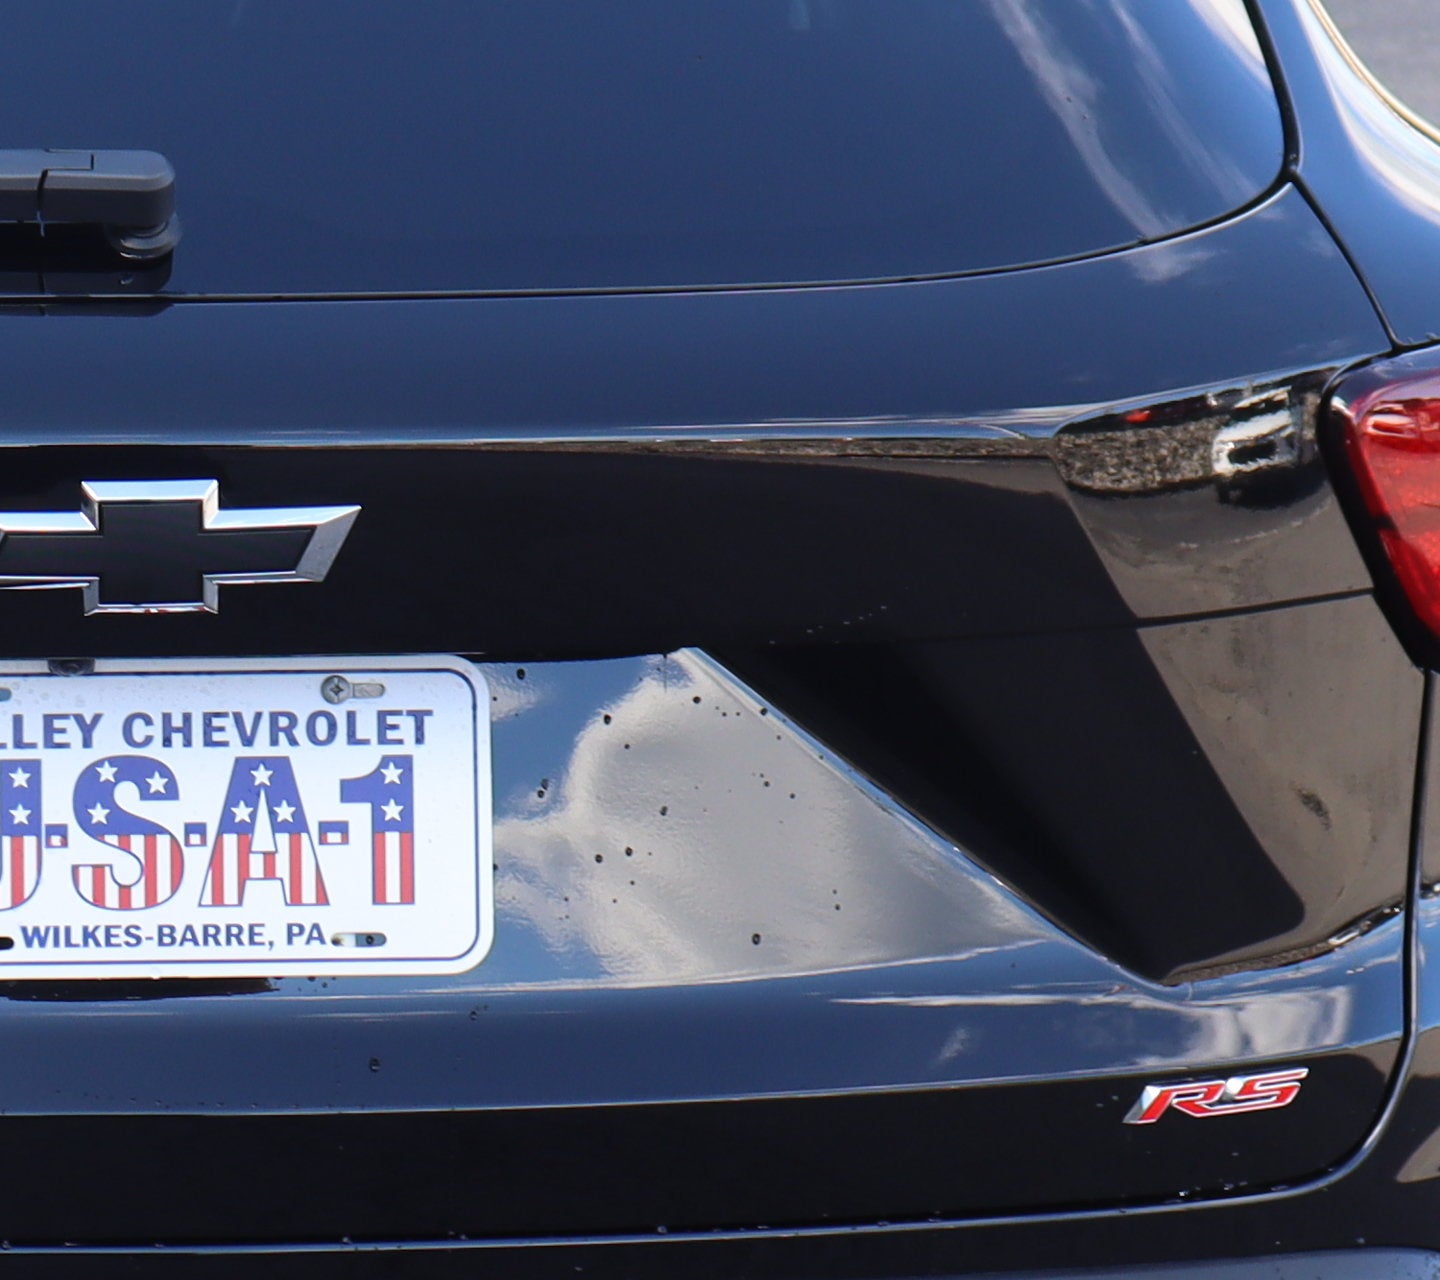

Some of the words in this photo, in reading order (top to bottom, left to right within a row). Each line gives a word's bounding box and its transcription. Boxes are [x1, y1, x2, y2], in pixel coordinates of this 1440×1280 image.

[122, 709, 435, 748] CHEVROLET
[20, 924, 275, 952] WILKES-BARRE,
[285, 923, 326, 947] PA
[1122, 1068, 1310, 1124] RS
